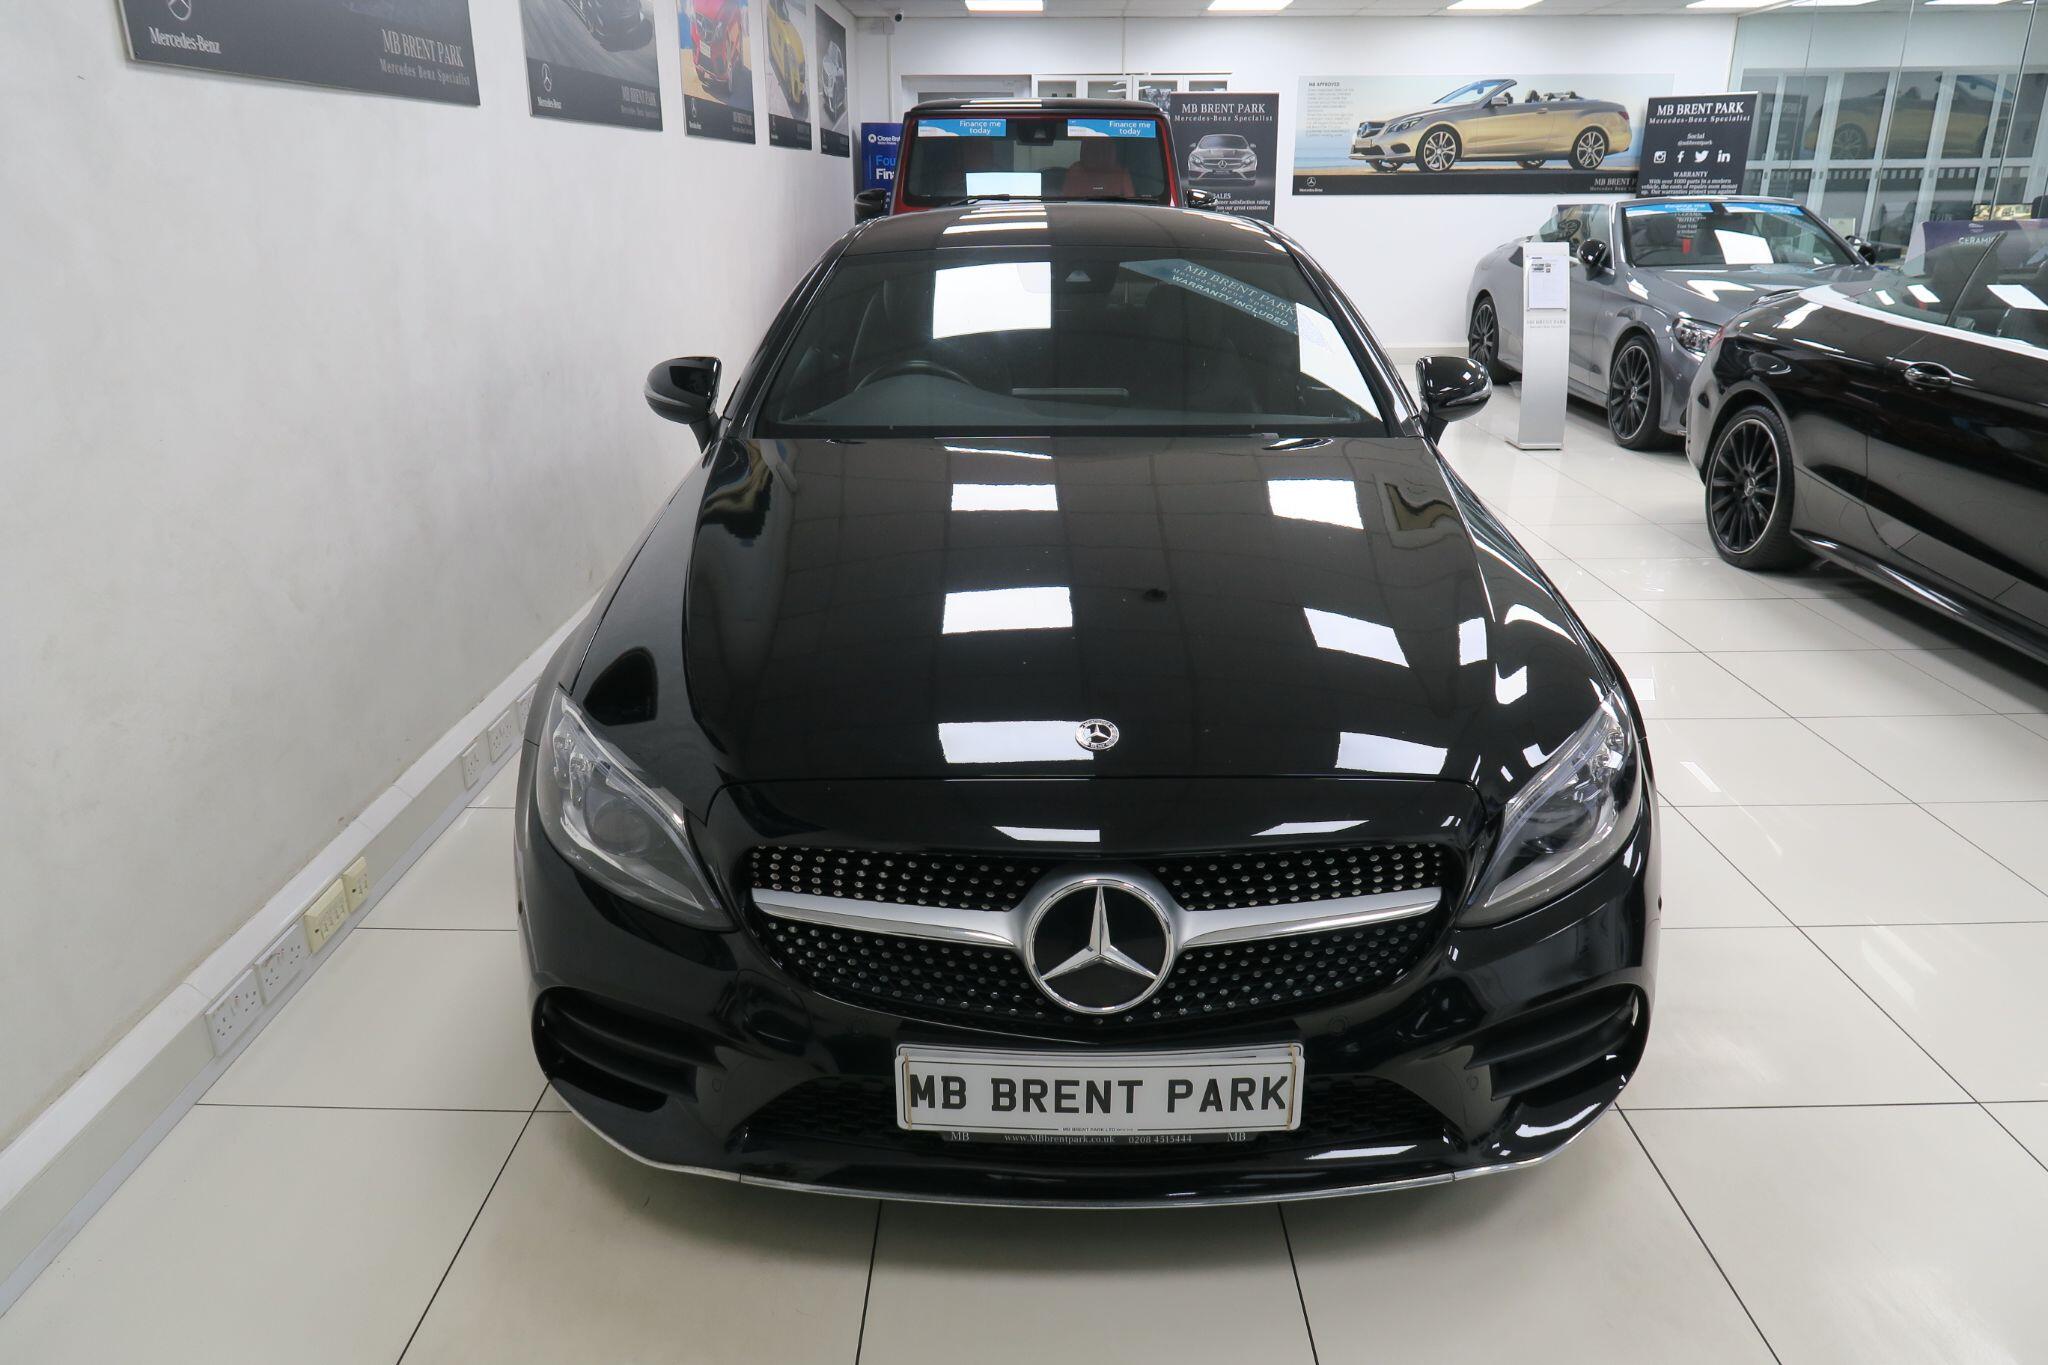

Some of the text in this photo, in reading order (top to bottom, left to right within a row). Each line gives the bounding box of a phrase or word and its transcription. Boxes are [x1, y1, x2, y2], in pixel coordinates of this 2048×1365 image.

[148, 26, 222, 54] Mercedes-Benz
[382, 28, 464, 68] MB BRENT PARK
[1182, 104, 1265, 113] MB BRENT PARK
[1657, 102, 1744, 116] MB BRENT PARK
[1109, 120, 1137, 128] Finance
[1234, 115, 1272, 123] Specialist
[1649, 115, 1750, 124] Mercedes-Benz Specialist
[969, 126, 991, 135] today
[1120, 127, 1141, 136] today
[1185, 265, 1297, 316] MB BRENT PARK
[1172, 274, 1289, 326] WARRANTY INCLUDED
[910, 1075, 1288, 1114] MB BRENT PARK
[951, 1132, 1247, 1145] MB www.MBbrentpark.co.uk 0208 4515444 MB
